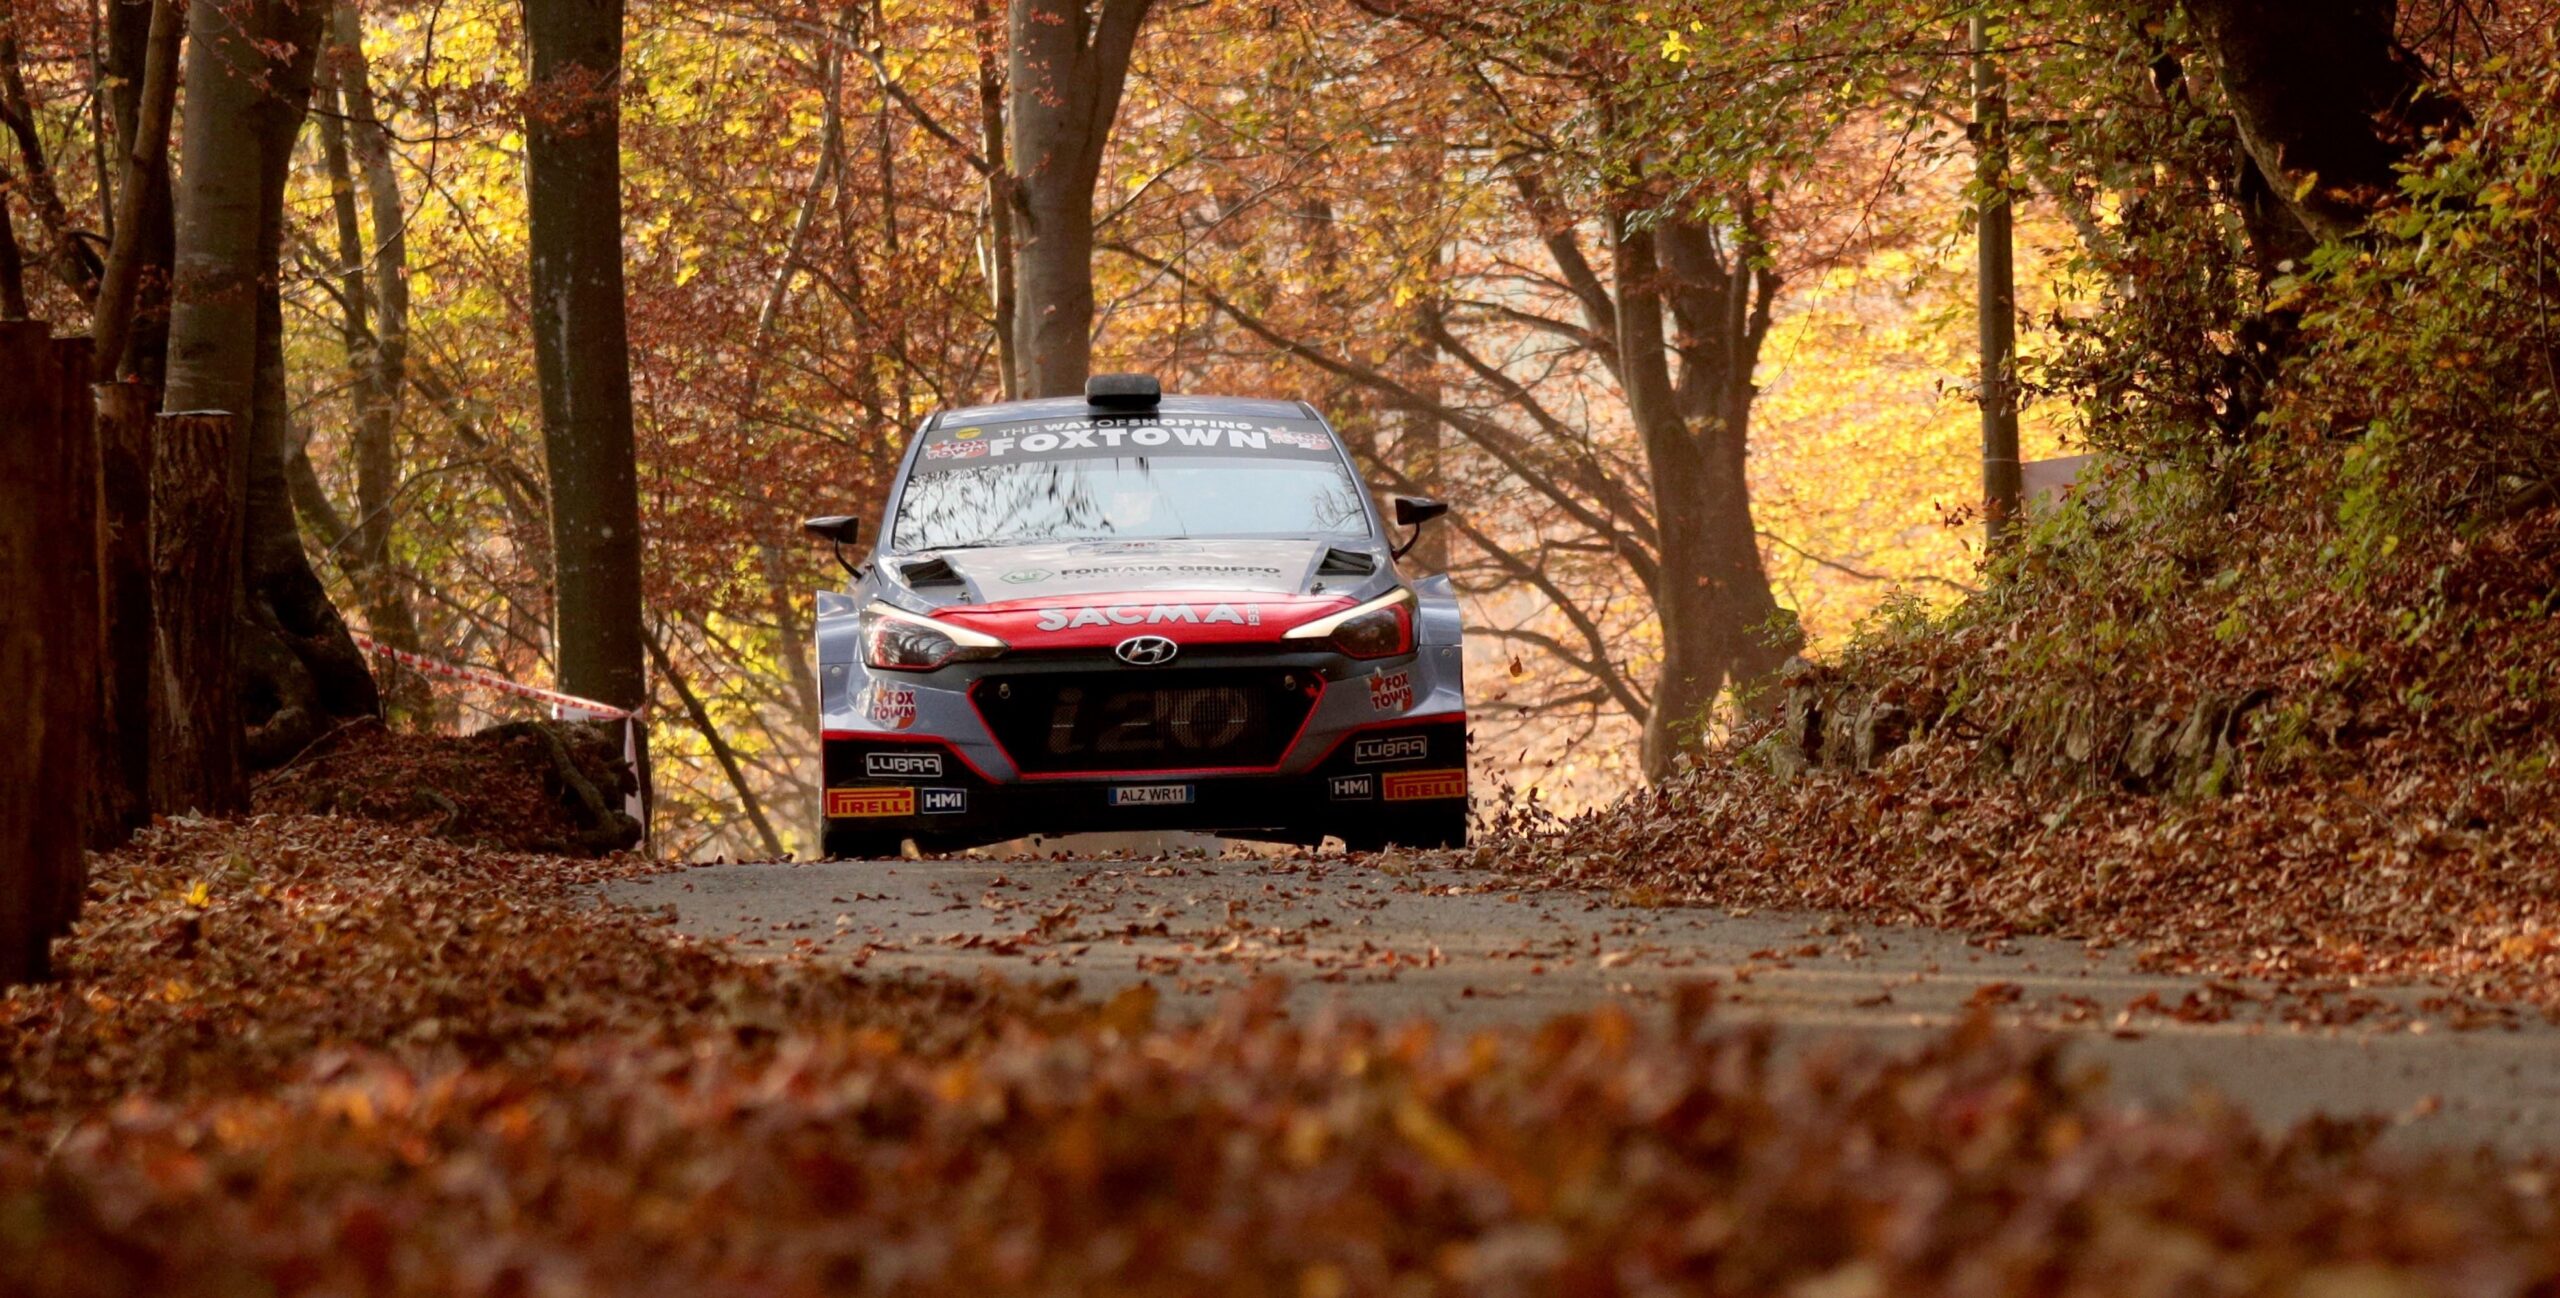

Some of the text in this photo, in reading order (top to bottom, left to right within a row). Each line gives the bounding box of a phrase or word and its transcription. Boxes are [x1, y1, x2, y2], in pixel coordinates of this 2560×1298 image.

[1000, 425, 1039, 437] THE
[990, 427, 1267, 456] FOXTOWN
[1061, 565, 1281, 575] FONTANA GRUPPO
[1036, 603, 1245, 631] SACMA
[1385, 672, 1409, 691] FOX
[887, 691, 914, 705] FOX
[1371, 687, 1412, 710] TOWN
[873, 706, 915, 720] TOWN
[1357, 740, 1424, 757] LUBRA
[869, 757, 940, 772] LUBRA
[1334, 780, 1368, 795] HMI
[1384, 771, 1464, 799] PIRELLI
[829, 789, 913, 814] PIRELLI
[925, 793, 962, 808] HMI
[1120, 788, 1184, 801] ALZ WR11
